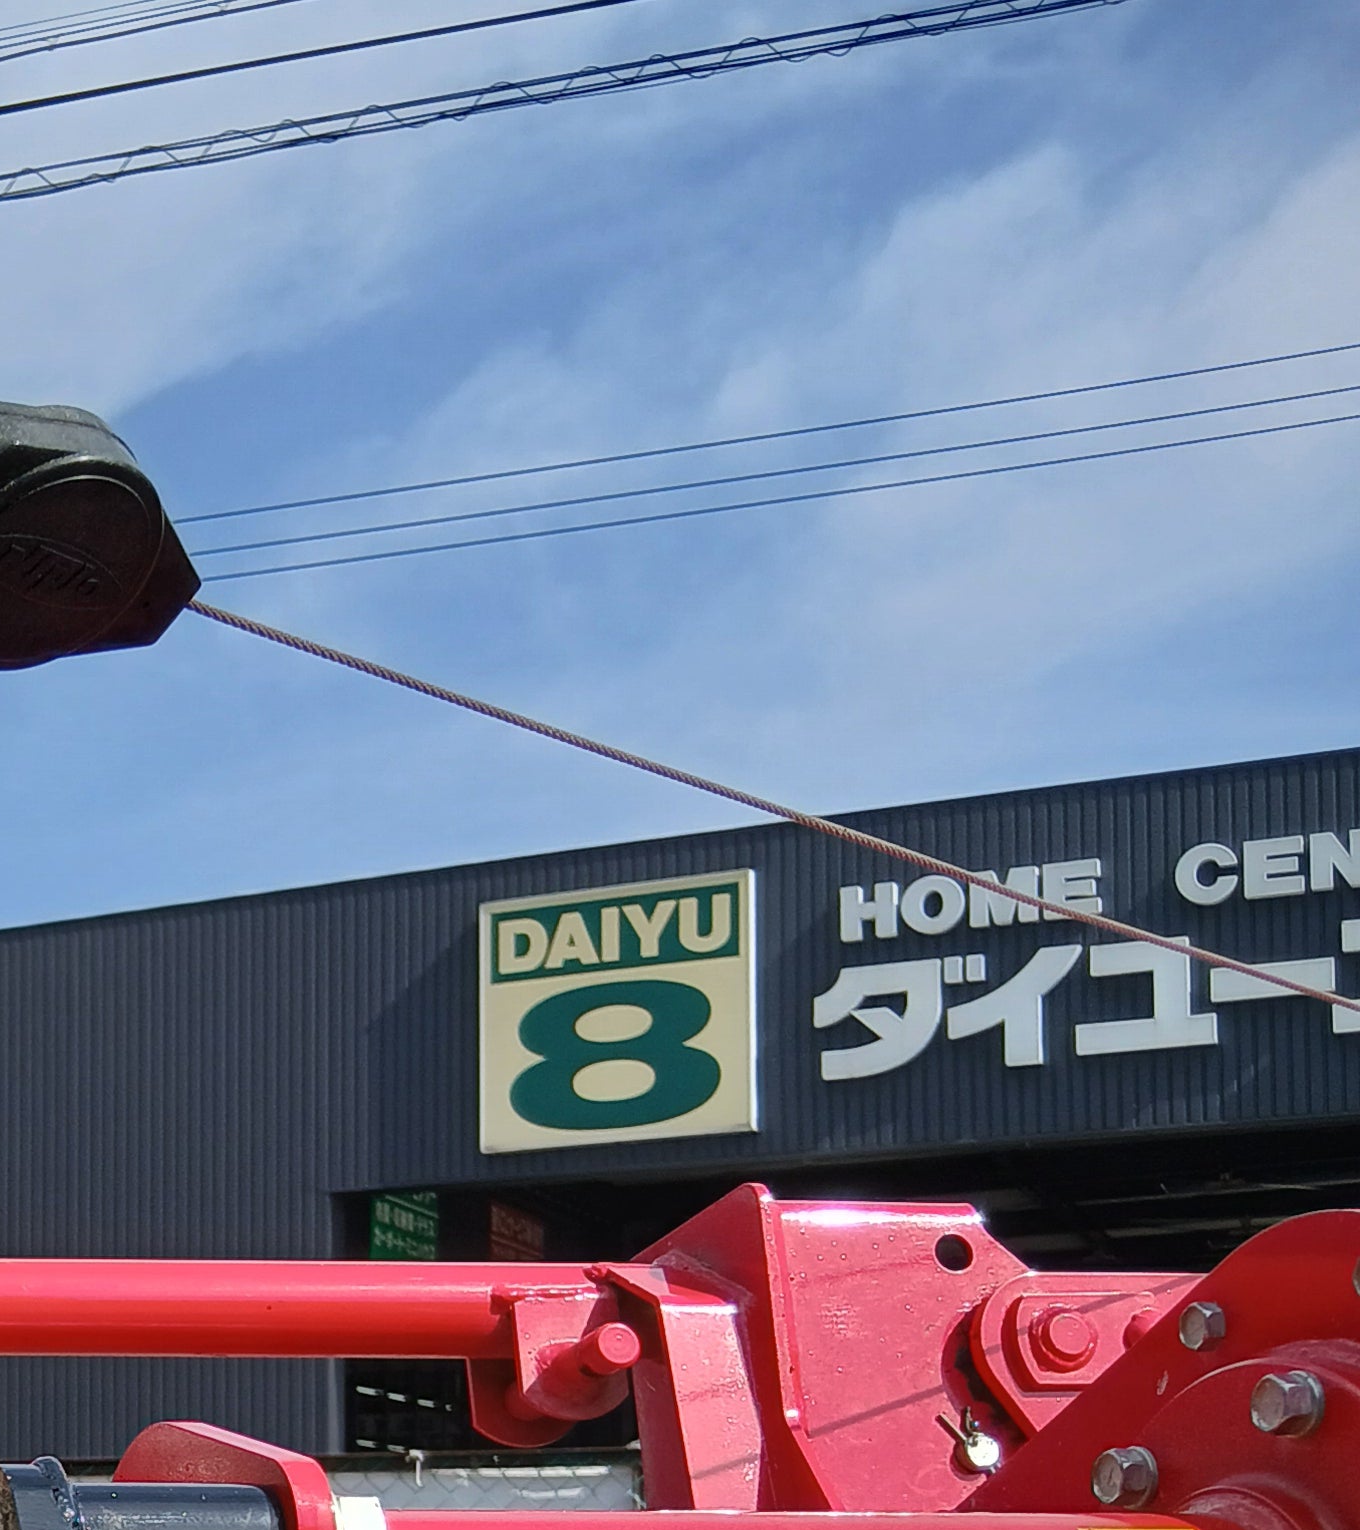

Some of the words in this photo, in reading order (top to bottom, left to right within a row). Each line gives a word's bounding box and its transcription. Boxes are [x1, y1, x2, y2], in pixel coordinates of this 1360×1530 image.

[496, 896, 732, 977] DAIYU
[838, 856, 1103, 944] HOME
[1174, 828, 1360, 906] CEN
[508, 978, 722, 1130] 8
[812, 917, 1360, 1081] ダイユー
